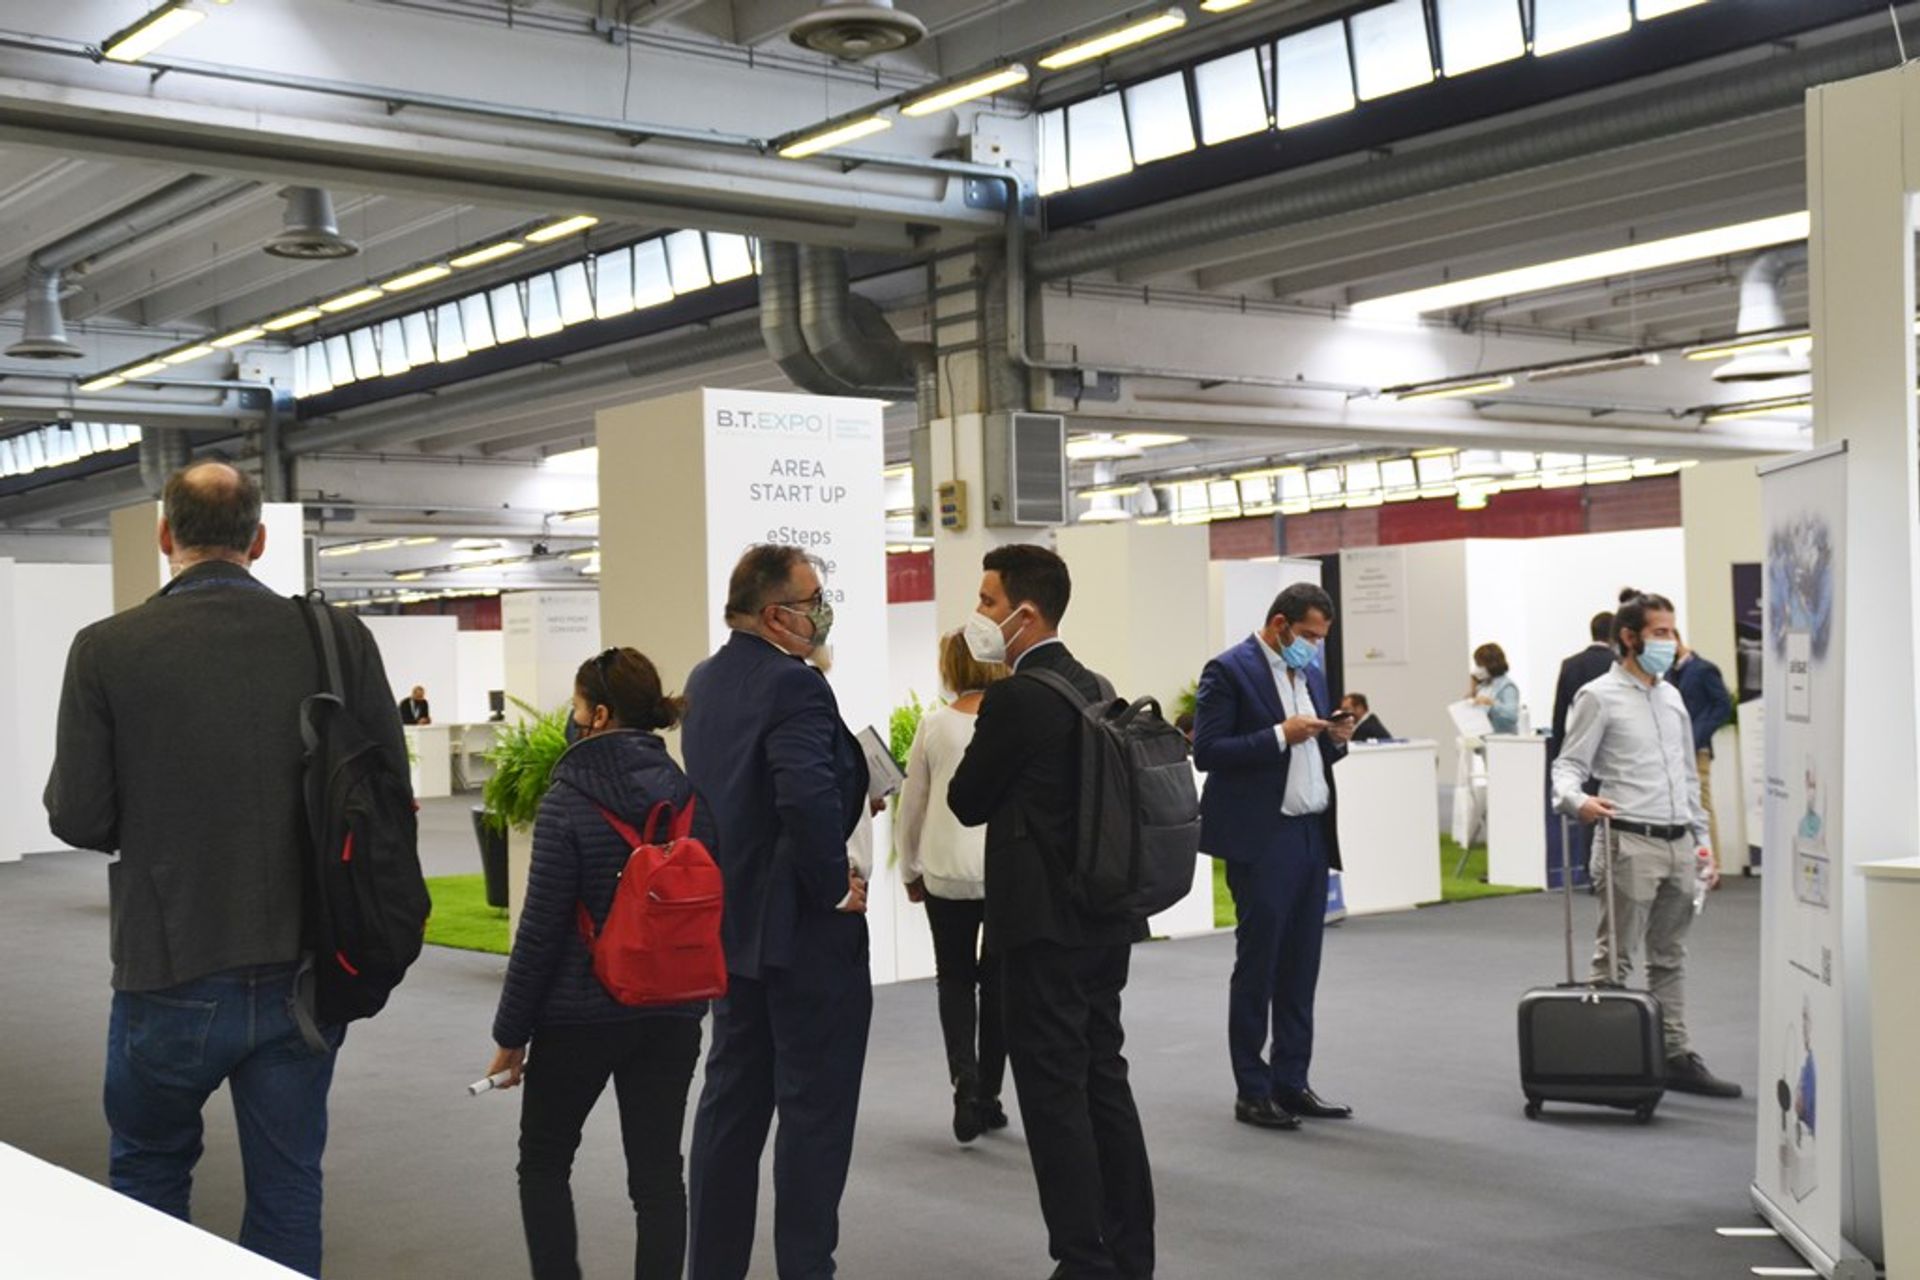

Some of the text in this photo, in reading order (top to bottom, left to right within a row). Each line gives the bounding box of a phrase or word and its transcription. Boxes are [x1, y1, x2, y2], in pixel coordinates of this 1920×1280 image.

[717, 409, 823, 433] B.T.EXPO
[770, 459, 826, 478] AREA
[750, 483, 847, 504] START UP
[766, 526, 832, 547] eSteps
